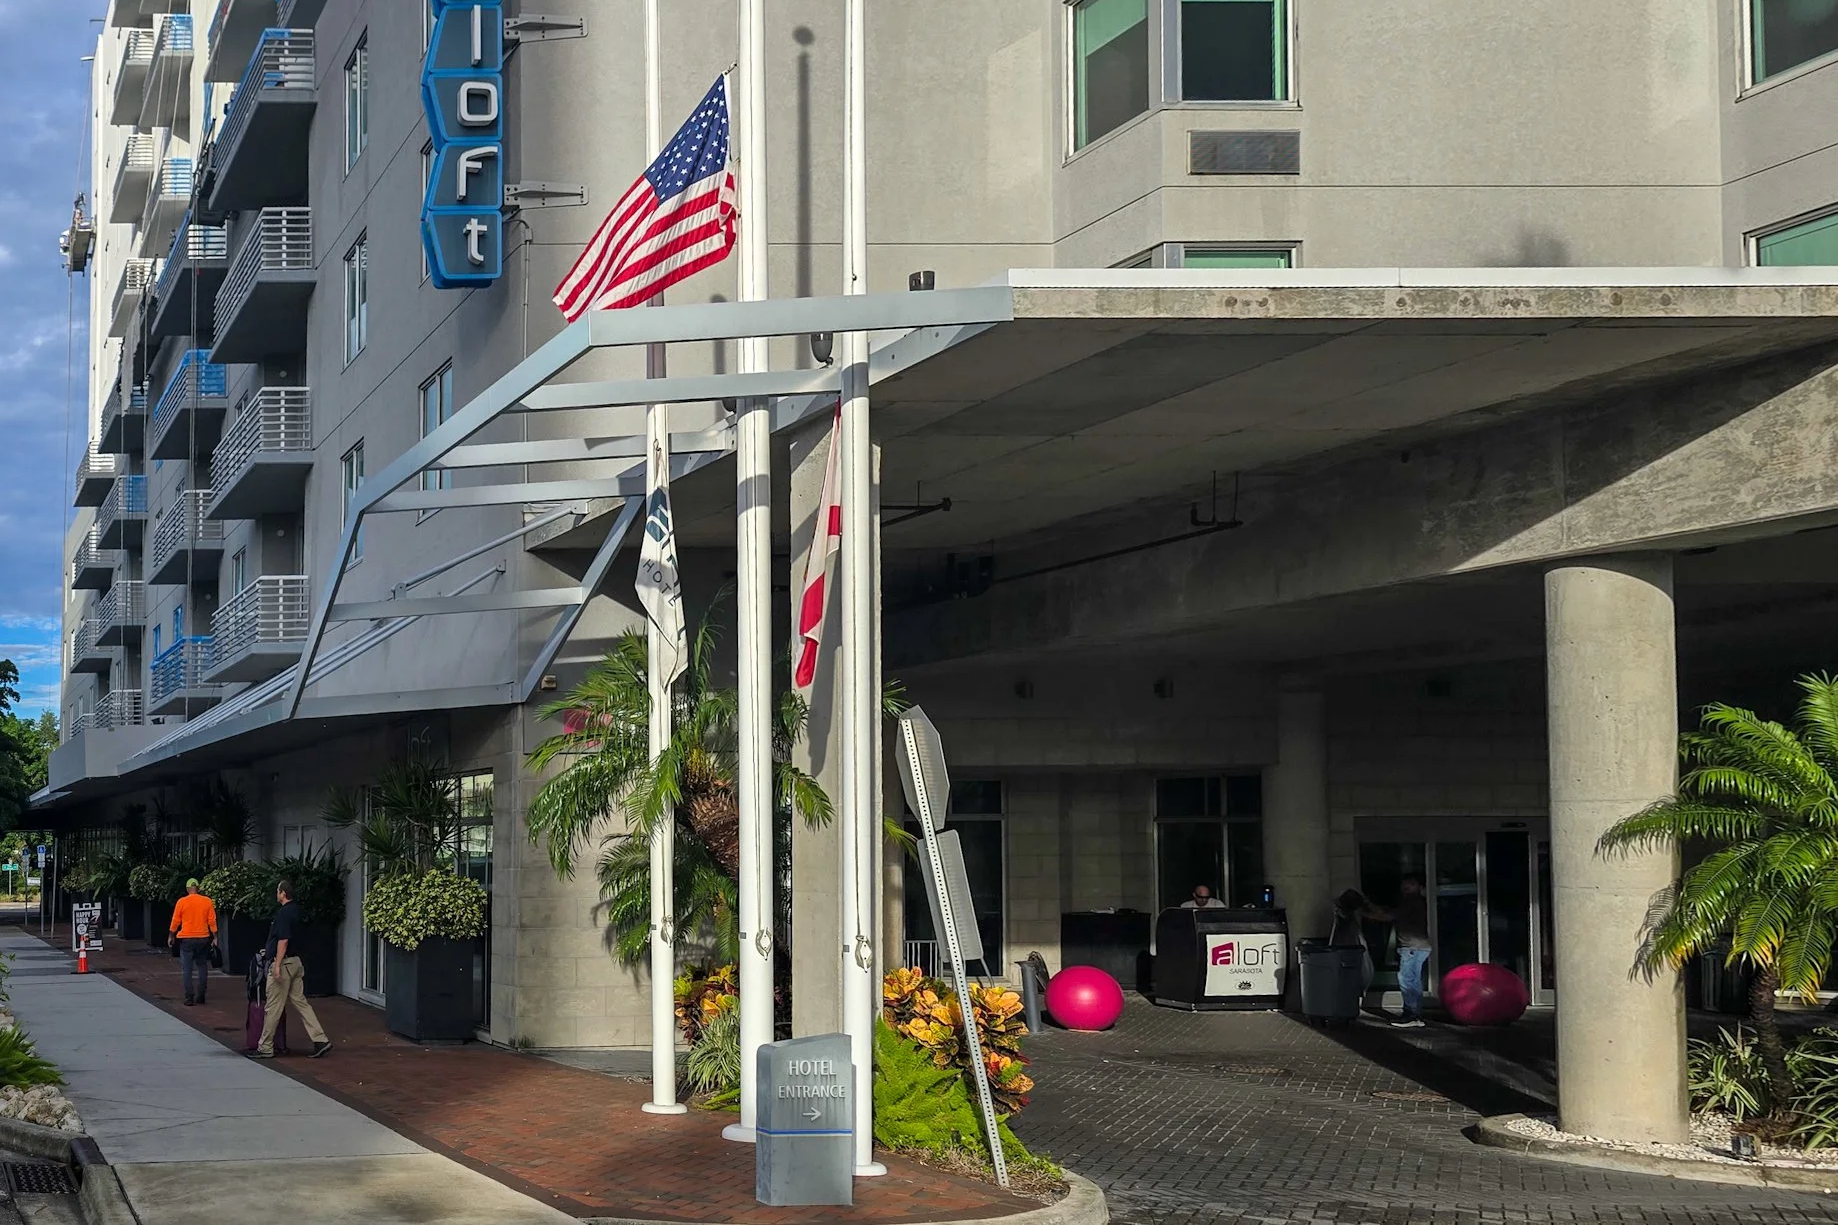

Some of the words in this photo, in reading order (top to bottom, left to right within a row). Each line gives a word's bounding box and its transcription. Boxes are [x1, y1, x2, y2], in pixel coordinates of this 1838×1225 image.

[1211, 941, 1280, 966] aloft
[788, 1060, 837, 1076] HOTEL
[778, 1085, 846, 1099] ENTRANCE
